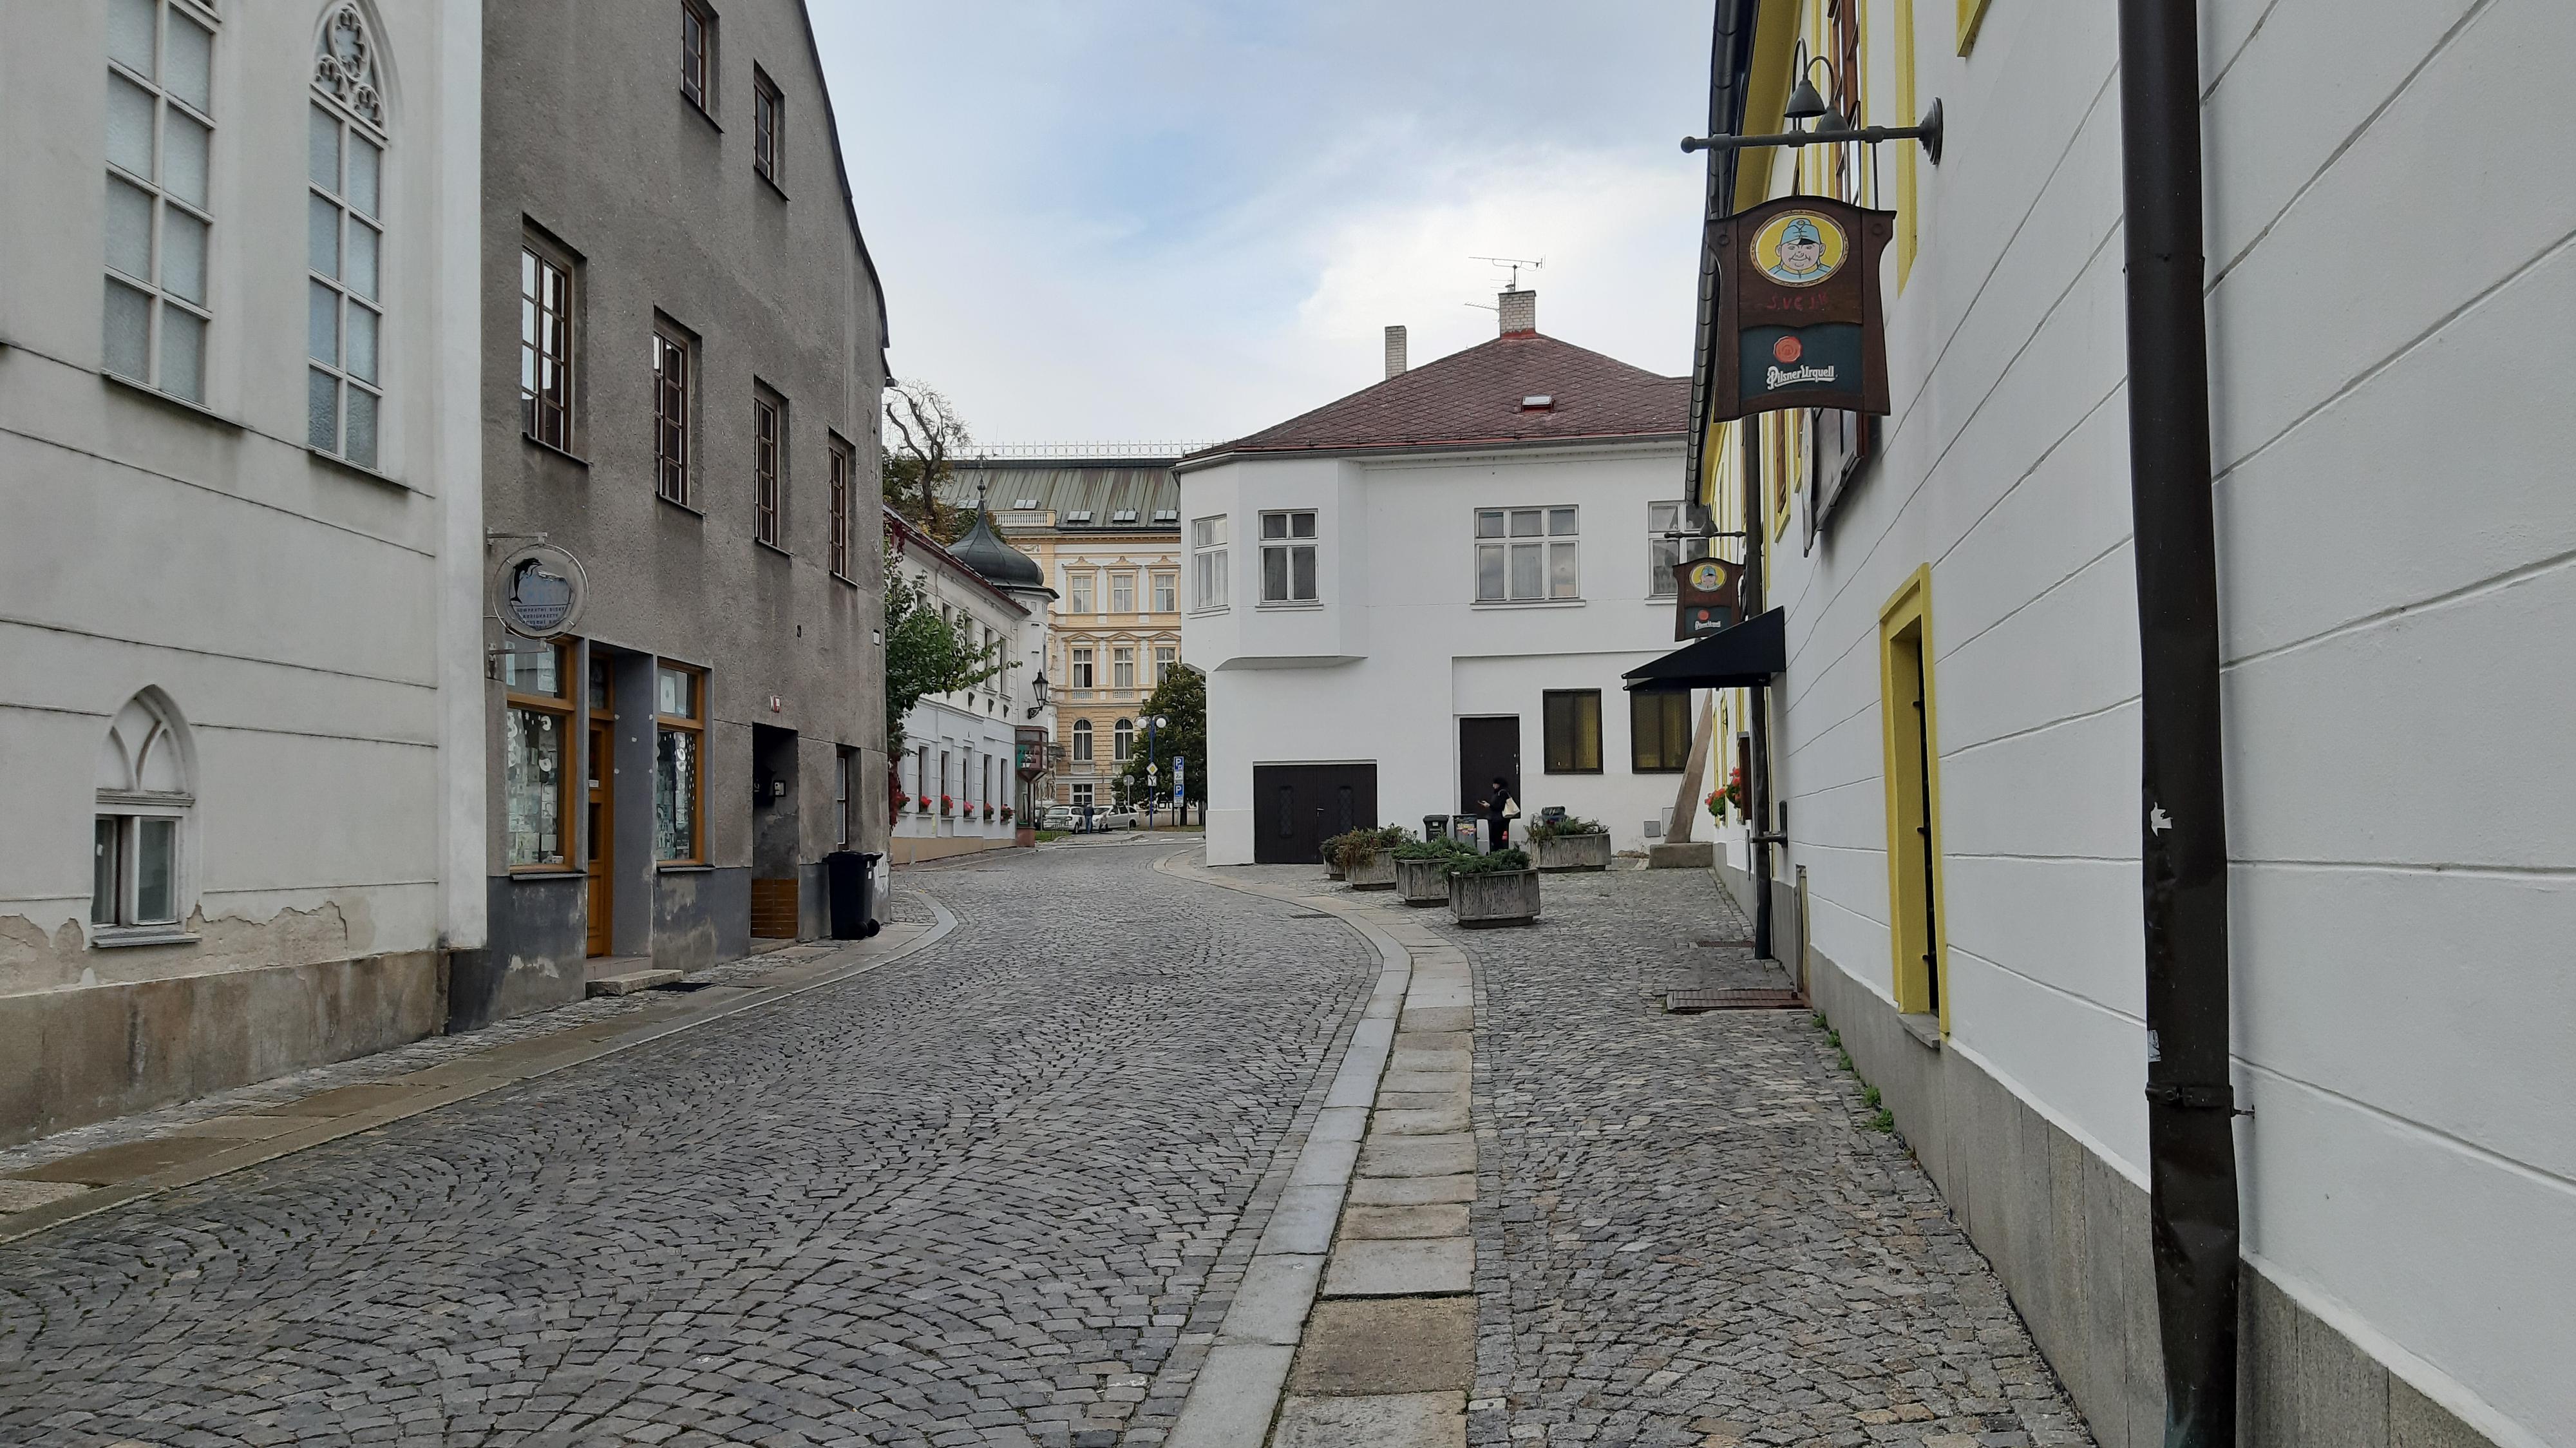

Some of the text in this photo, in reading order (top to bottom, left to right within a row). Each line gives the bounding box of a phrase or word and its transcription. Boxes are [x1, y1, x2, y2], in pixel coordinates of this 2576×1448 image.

[1766, 365, 1835, 390] Pilsner Urquell
[1176, 758, 1182, 767] P
[1176, 786, 1182, 794] P
